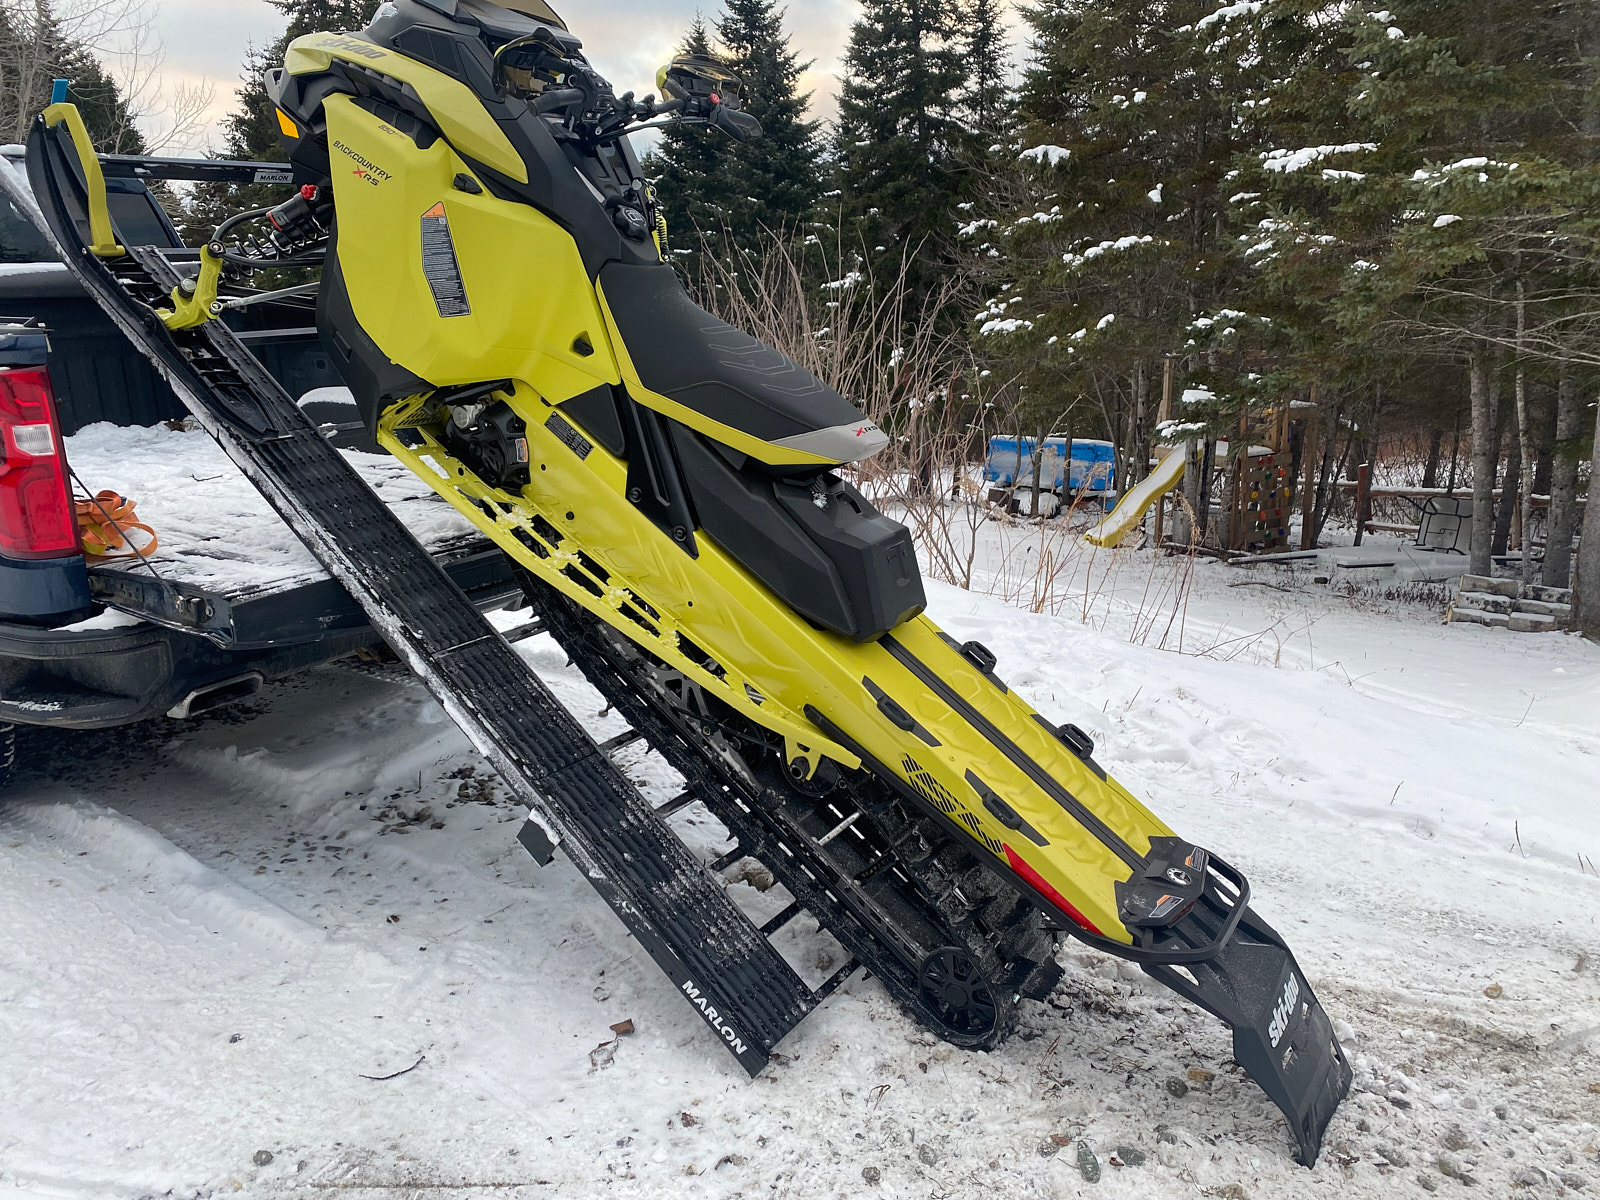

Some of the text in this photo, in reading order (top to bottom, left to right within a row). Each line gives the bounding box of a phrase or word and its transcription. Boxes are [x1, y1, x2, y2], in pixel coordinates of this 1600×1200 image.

[333, 140, 393, 181] BACKCOUNTRY
[352, 165, 380, 186] XRS
[681, 979, 748, 1055] MARLON
